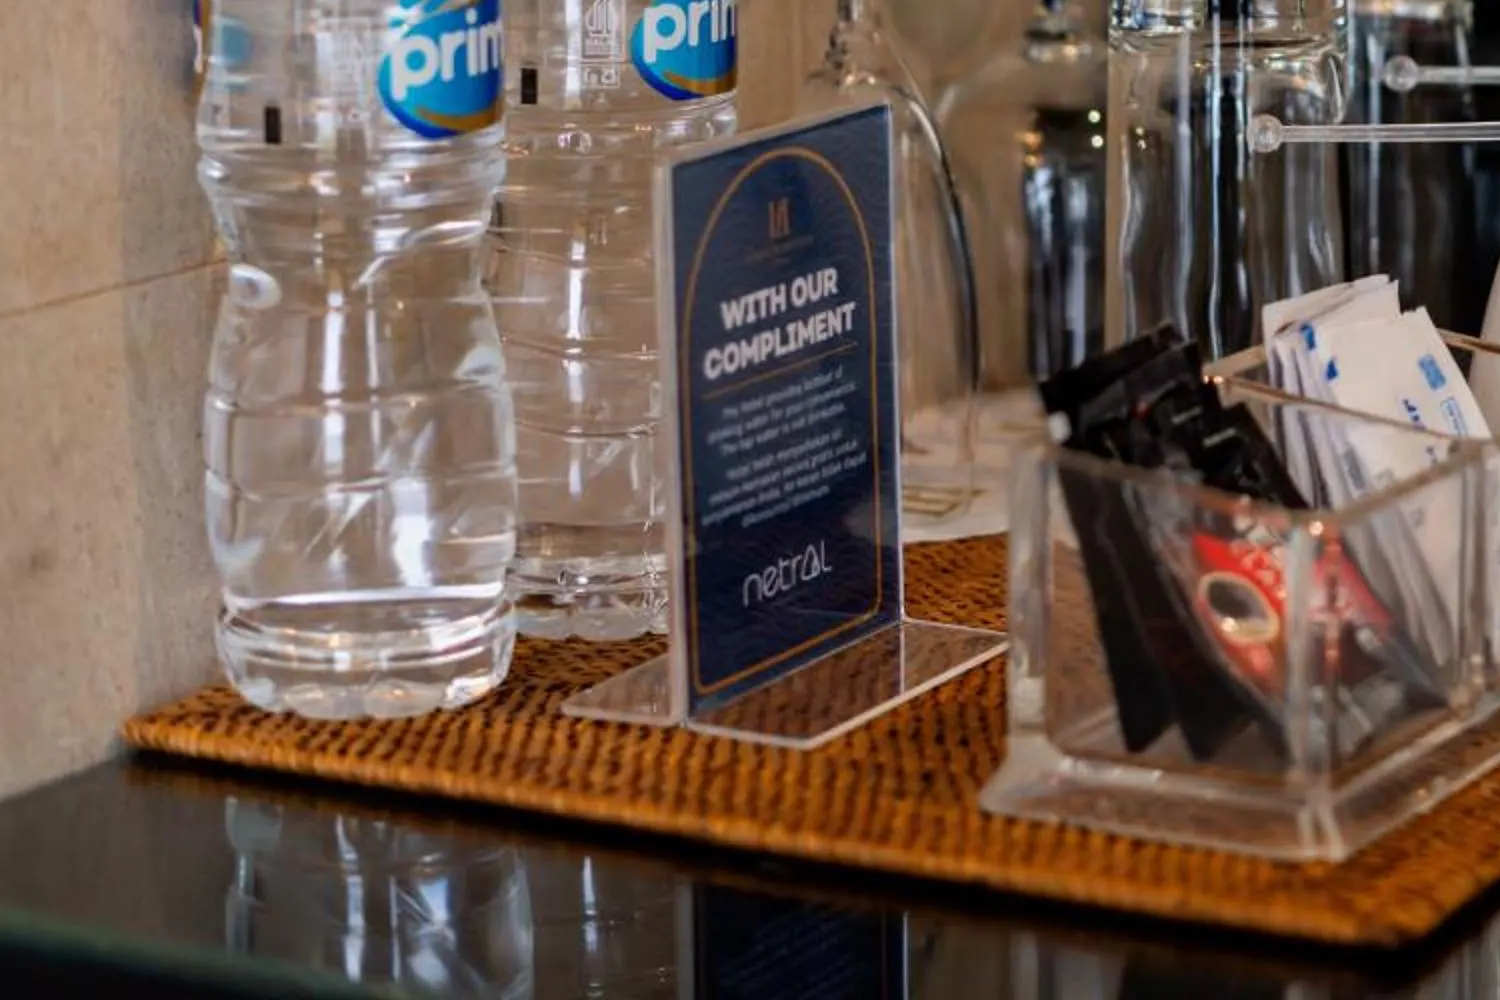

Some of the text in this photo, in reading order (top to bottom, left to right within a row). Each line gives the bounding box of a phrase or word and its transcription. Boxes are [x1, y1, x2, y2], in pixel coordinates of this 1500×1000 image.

[720, 267, 839, 331] WITH OUR
[703, 301, 856, 380] COMPLIMENT
